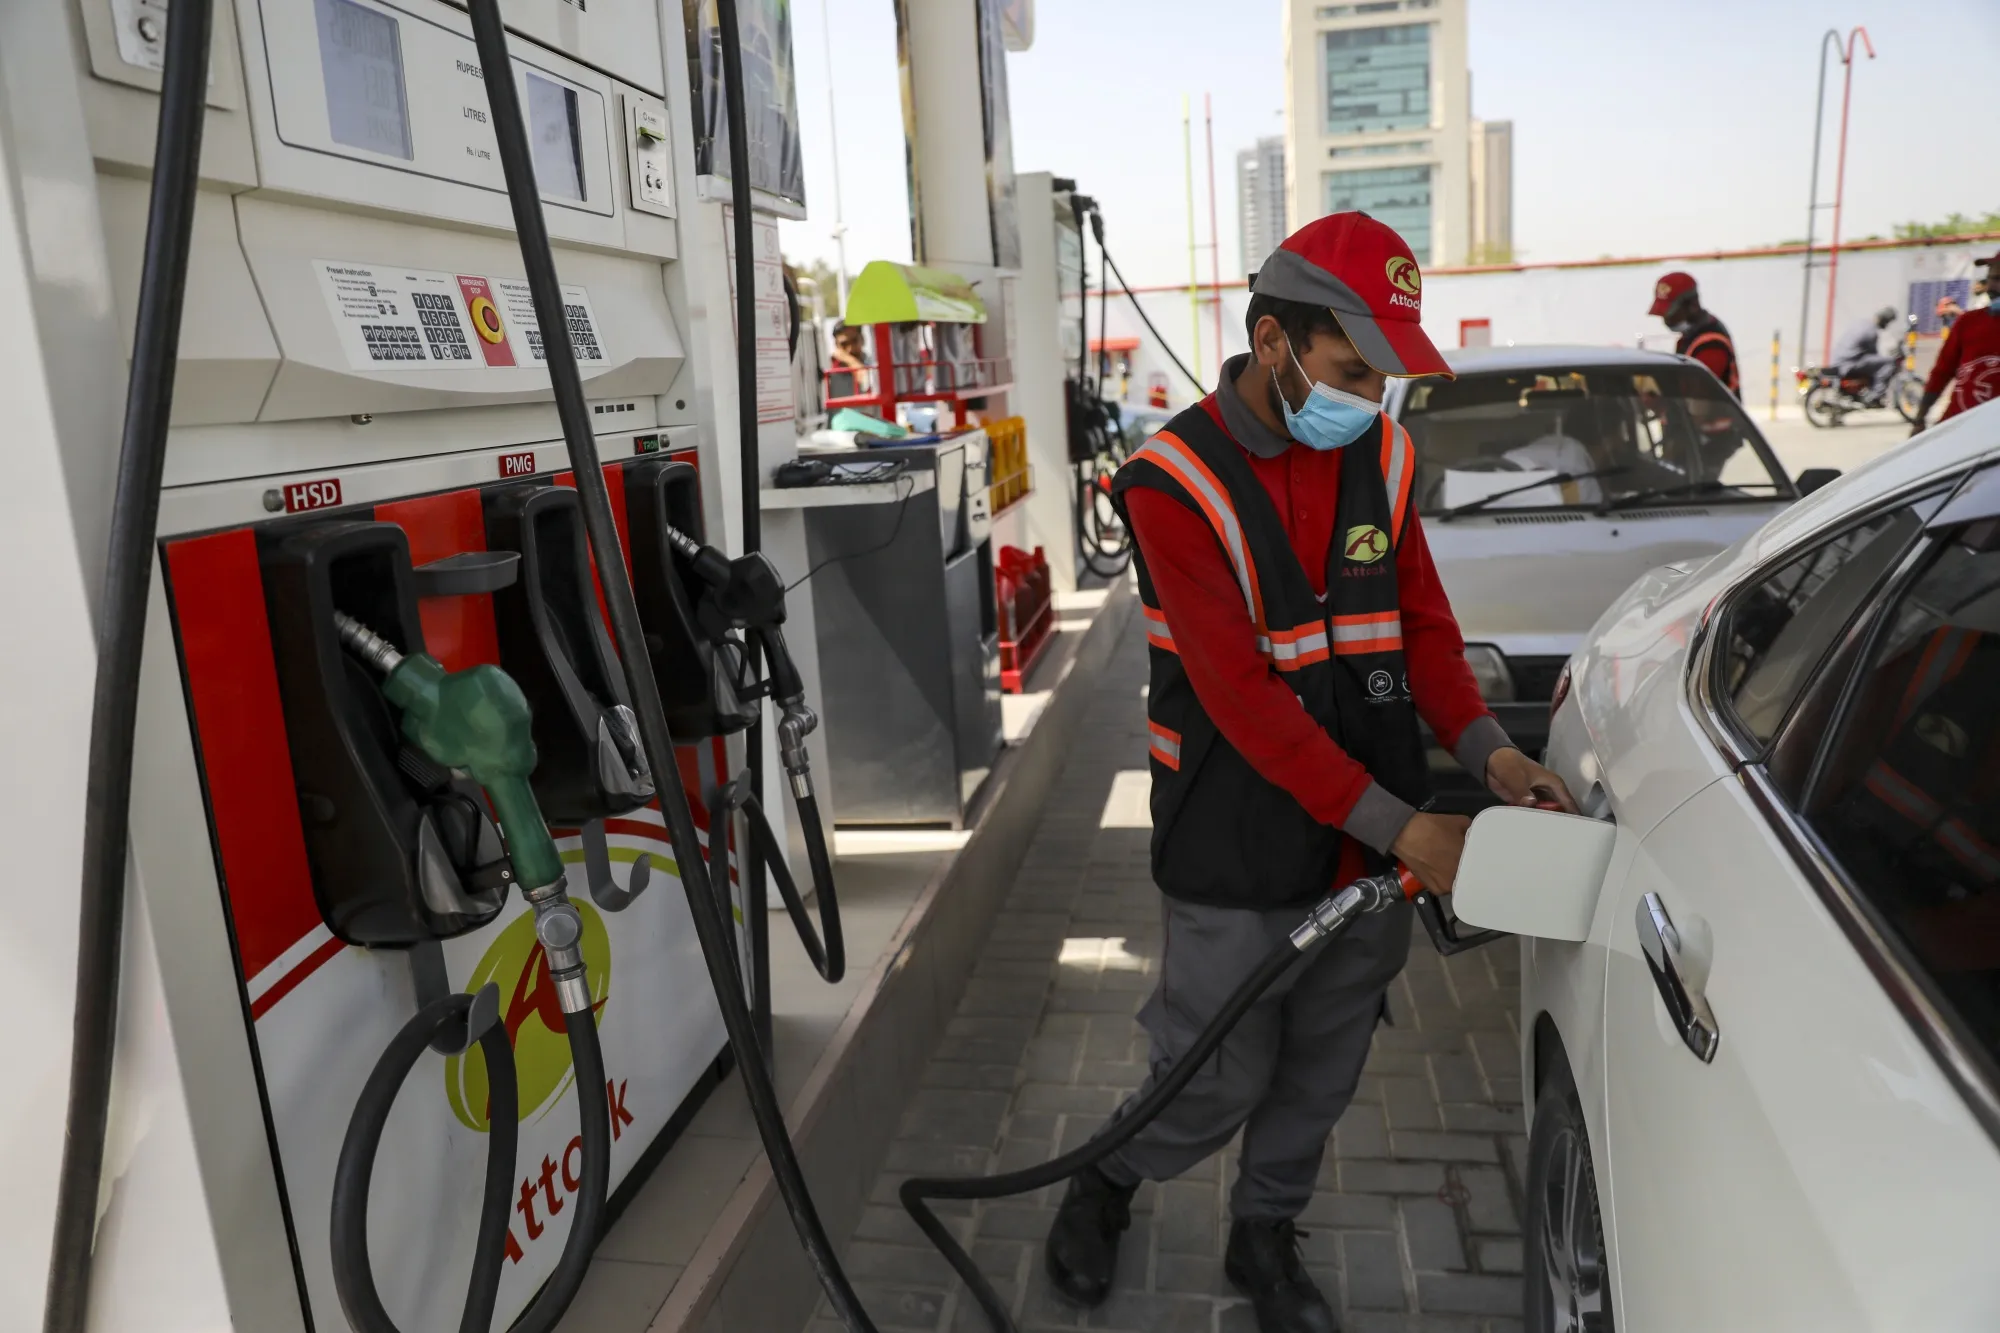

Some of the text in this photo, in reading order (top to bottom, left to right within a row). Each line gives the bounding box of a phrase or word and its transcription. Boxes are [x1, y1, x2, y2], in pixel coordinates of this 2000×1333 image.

[456, 59, 484, 80] RUPEES
[463, 105, 487, 124] LITRES
[477, 149, 491, 161] LITRE
[326, 265, 373, 277] Preset Instruction
[460, 278, 485, 287] EMERGENCY
[414, 295, 453, 306] 7 8 9 F1
[1389, 292, 1420, 311] Attoc
[421, 313, 458, 324] 4 5 6 F2
[363, 328, 418, 340] P1 P2 P3 P4 P5
[437, 330, 444, 341] 2
[447, 330, 454, 341] 3
[370, 347, 380, 357] P6
[382, 347, 391, 357] P7
[393, 347, 403, 357] P8
[404, 347, 413, 357] P9
[434, 347, 440, 357] 0
[443, 346, 451, 358] C
[505, 454, 532, 475] PMG
[291, 481, 338, 510] HSD
